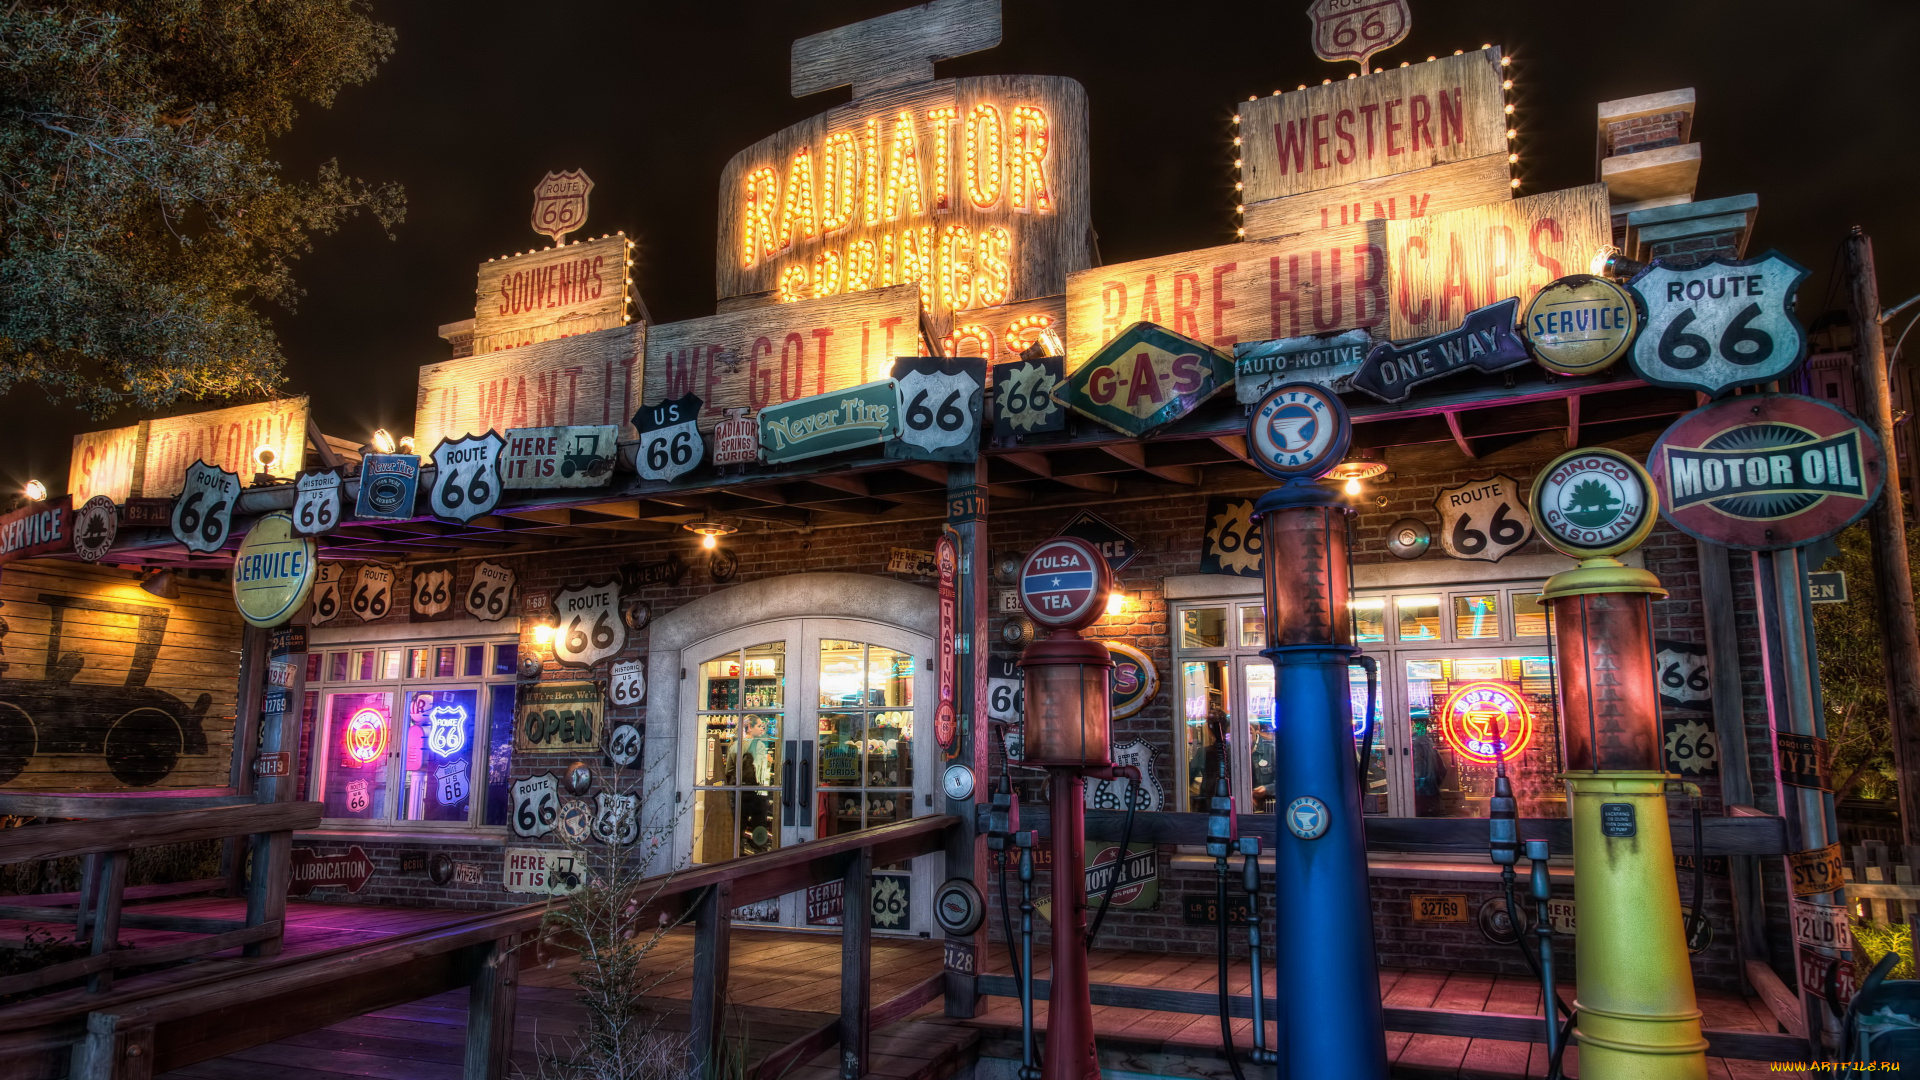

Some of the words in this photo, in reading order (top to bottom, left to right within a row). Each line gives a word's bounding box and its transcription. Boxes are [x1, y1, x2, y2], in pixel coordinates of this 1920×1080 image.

[1333, 10, 1385, 47] 66
[1274, 87, 1464, 175] WESTERN
[546, 181, 578, 194] ROUTE
[745, 103, 1057, 269] RADIATOR
[542, 201, 574, 224] 66
[1399, 217, 1565, 326] CAPS
[500, 256, 604, 317] SOUVENIRS
[1102, 262, 1239, 347] RARE
[1270, 243, 1386, 342] HUB
[1667, 275, 1764, 302] ROUTE
[1533, 306, 1624, 337] SERVICE
[1658, 302, 1775, 370] 66
[665, 344, 725, 416] WE
[750, 327, 834, 411] GOT
[861, 317, 903, 385] IT
[1242, 345, 1362, 374] AUTO-MOTIVE
[1379, 348, 1431, 387] ONE
[1436, 324, 1500, 373] WAY
[1089, 353, 1204, 407] G-A-S
[479, 365, 583, 436] WANT
[603, 355, 638, 427] IT
[1007, 378, 1049, 415] 66
[1261, 391, 1326, 418] BUTTE
[653, 404, 681, 426] US
[905, 388, 965, 432] 66
[716, 421, 756, 441] RADIATOR
[766, 410, 838, 452] Never
[840, 397, 889, 427] Tire
[446, 445, 488, 465] ROUTE
[510, 436, 558, 456] HERE
[646, 431, 693, 472] 66
[715, 450, 756, 462] CURIOS
[721, 438, 751, 451] SPRINGS
[367, 460, 397, 476] Never
[397, 459, 415, 475] Tire
[508, 460, 528, 479] IT
[535, 458, 555, 478] IS
[1273, 450, 1314, 467] GAS
[197, 471, 232, 494] ROUTE
[303, 477, 334, 488] HISTORIC
[1550, 458, 1630, 487] DINOCO
[1673, 454, 1794, 499] MOTOR
[1801, 443, 1859, 488] OIL
[312, 491, 324, 500] US
[441, 464, 490, 509] 66
[1450, 483, 1503, 507] ROUTE
[81, 495, 116, 517] DINOCO
[179, 491, 227, 543] 66
[300, 499, 332, 527] 66
[1, 507, 63, 550] SERVICE
[1452, 502, 1525, 555] 66
[1547, 502, 1639, 544] GASOLINE
[75, 527, 115, 562] GASOLINE
[1218, 518, 1261, 555] 66
[236, 550, 302, 582] SERVICE
[891, 560, 903, 569] IT
[904, 561, 915, 570] IS
[894, 551, 917, 562] HERE
[1035, 555, 1080, 570] TULSA
[365, 570, 389, 583] ROUTE
[482, 567, 509, 582] ROUTE
[312, 586, 336, 617] 6
[353, 584, 386, 615] 66
[418, 581, 447, 606] 66
[470, 581, 506, 615] 66
[568, 592, 610, 612] ROUTE
[1042, 595, 1072, 610] TEA
[565, 610, 615, 654] 66
[614, 664, 640, 674] HISTORIC
[1662, 661, 1709, 692] 66
[615, 679, 641, 700] 66
[1456, 690, 1514, 713] BUTTE
[434, 727, 459, 748] 66
[525, 708, 593, 745] OPEN
[611, 733, 638, 756] 66
[1674, 733, 1715, 760] 66
[445, 775, 458, 784] US
[519, 780, 549, 795] ROUTE
[351, 796, 365, 809] 66
[445, 782, 462, 801] 66
[517, 793, 557, 831] 66
[603, 798, 631, 810] ROUTE
[1290, 798, 1323, 812] BUTTE
[599, 810, 631, 838] 66
[1296, 829, 1317, 839] GAS
[294, 860, 366, 881] LUBRICATION
[511, 854, 545, 870] HERE
[1131, 856, 1154, 878] OIL
[509, 871, 524, 886] IT
[529, 872, 544, 887] IS
[809, 881, 843, 904] SERVI
[873, 889, 901, 914] 66
[1122, 887, 1138, 896] PURE
[809, 897, 843, 919] STATI
[1190, 904, 1202, 912] LR
[1421, 902, 1458, 916] 32769
